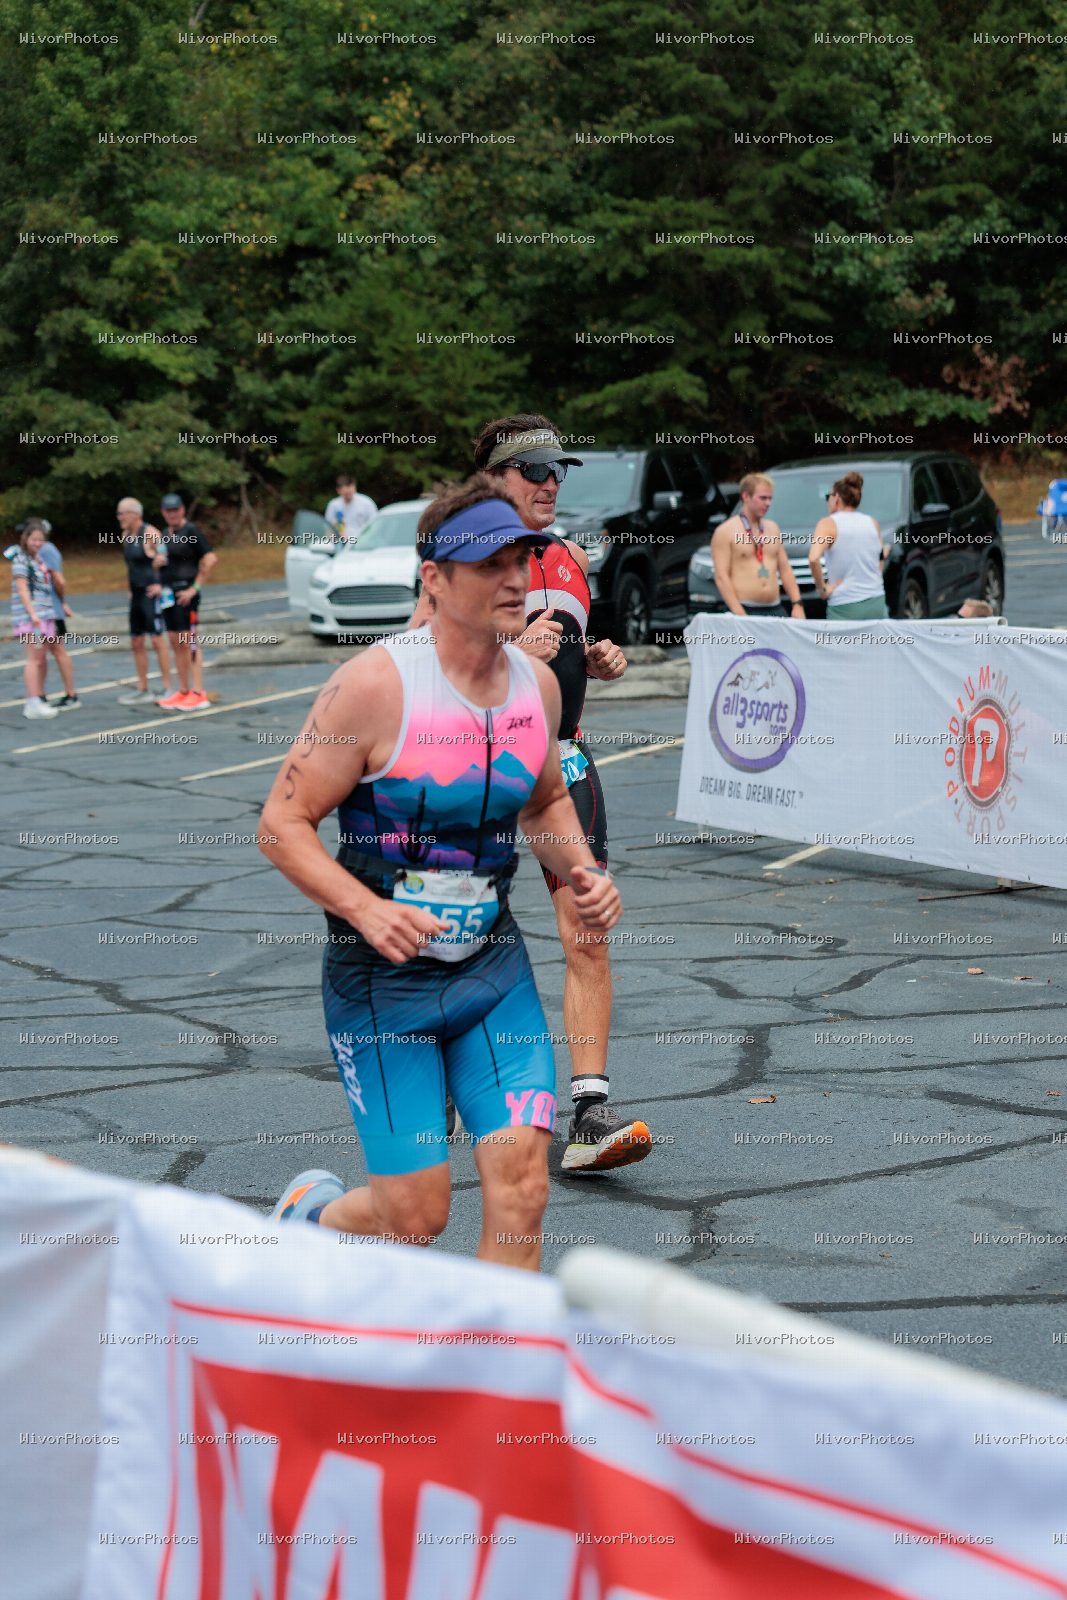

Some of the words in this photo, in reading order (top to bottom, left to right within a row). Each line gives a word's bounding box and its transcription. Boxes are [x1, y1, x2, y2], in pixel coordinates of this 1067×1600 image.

[699, 776, 727, 797] DREAM
[728, 780, 743, 801] BIG.
[745, 783, 773, 805] DREAM
[505, 1088, 557, 1134] YO
